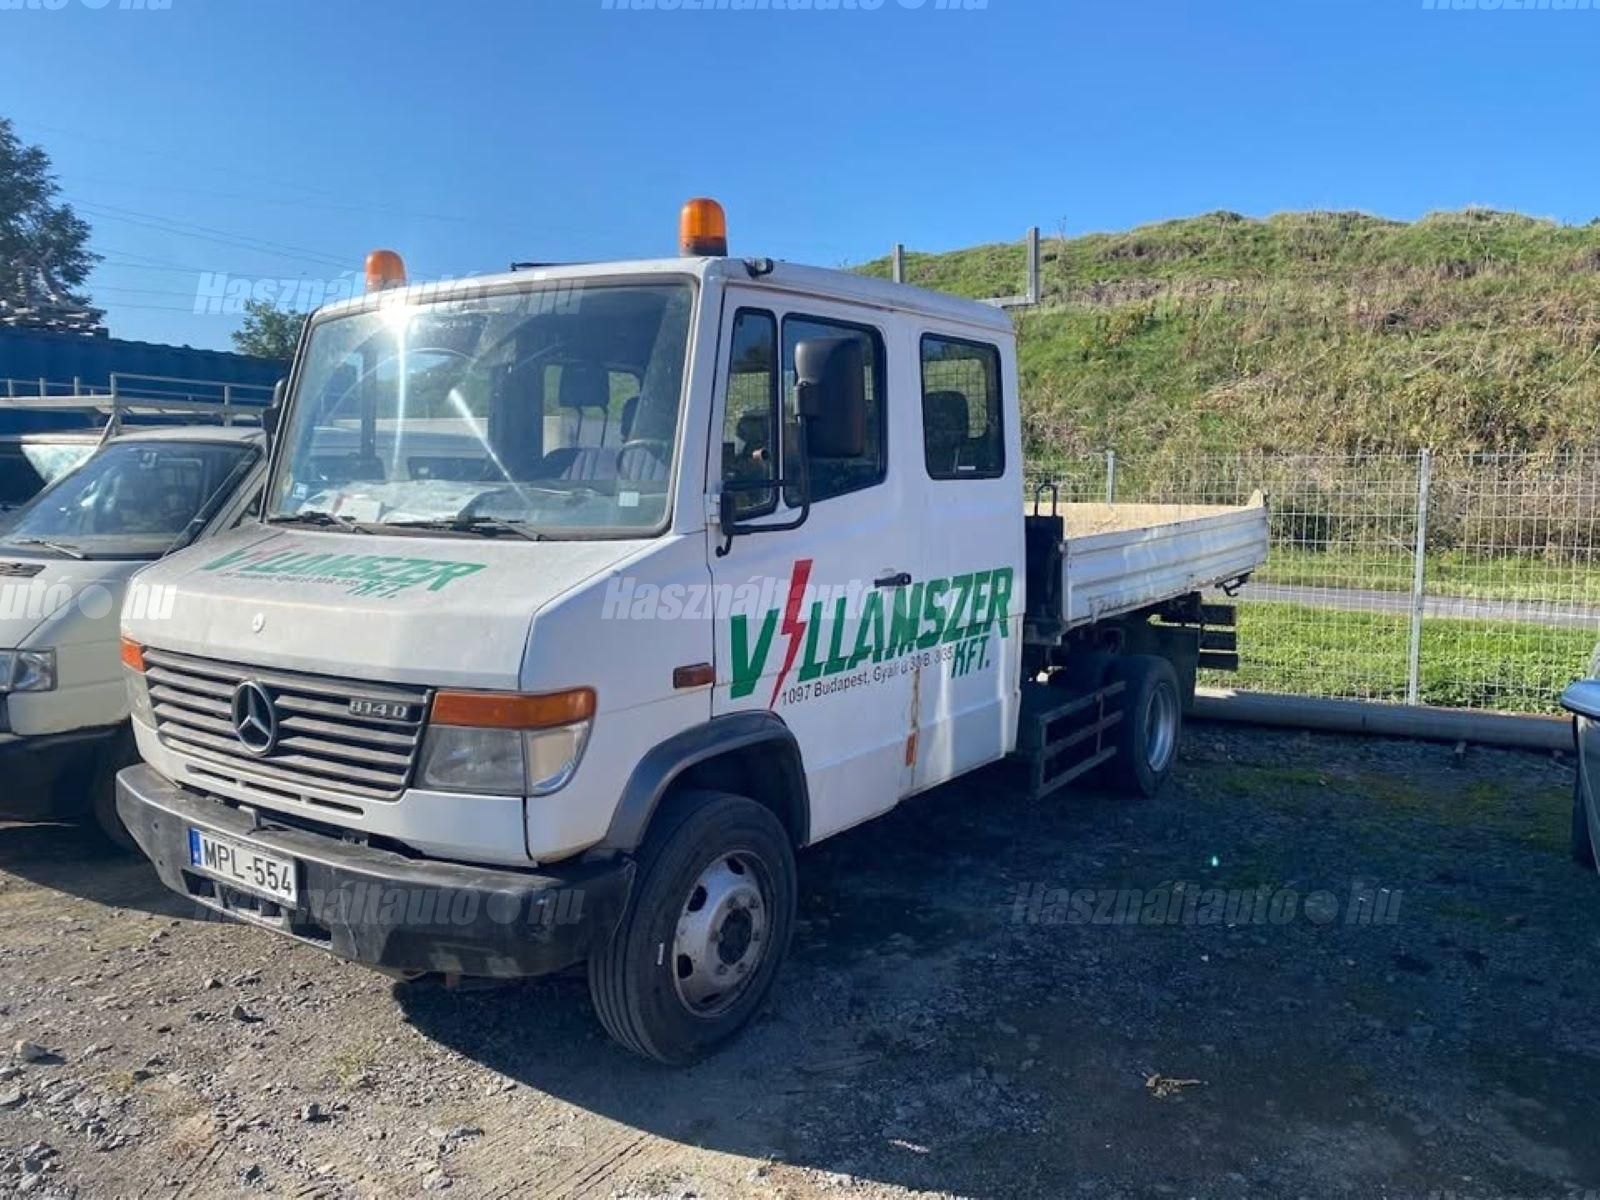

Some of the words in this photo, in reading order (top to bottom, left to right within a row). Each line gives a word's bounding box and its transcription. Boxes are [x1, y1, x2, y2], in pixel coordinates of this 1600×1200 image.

[951, 635, 991, 679] KFT.
[782, 685, 811, 706] 1097
[203, 838, 293, 897] MPL-554
